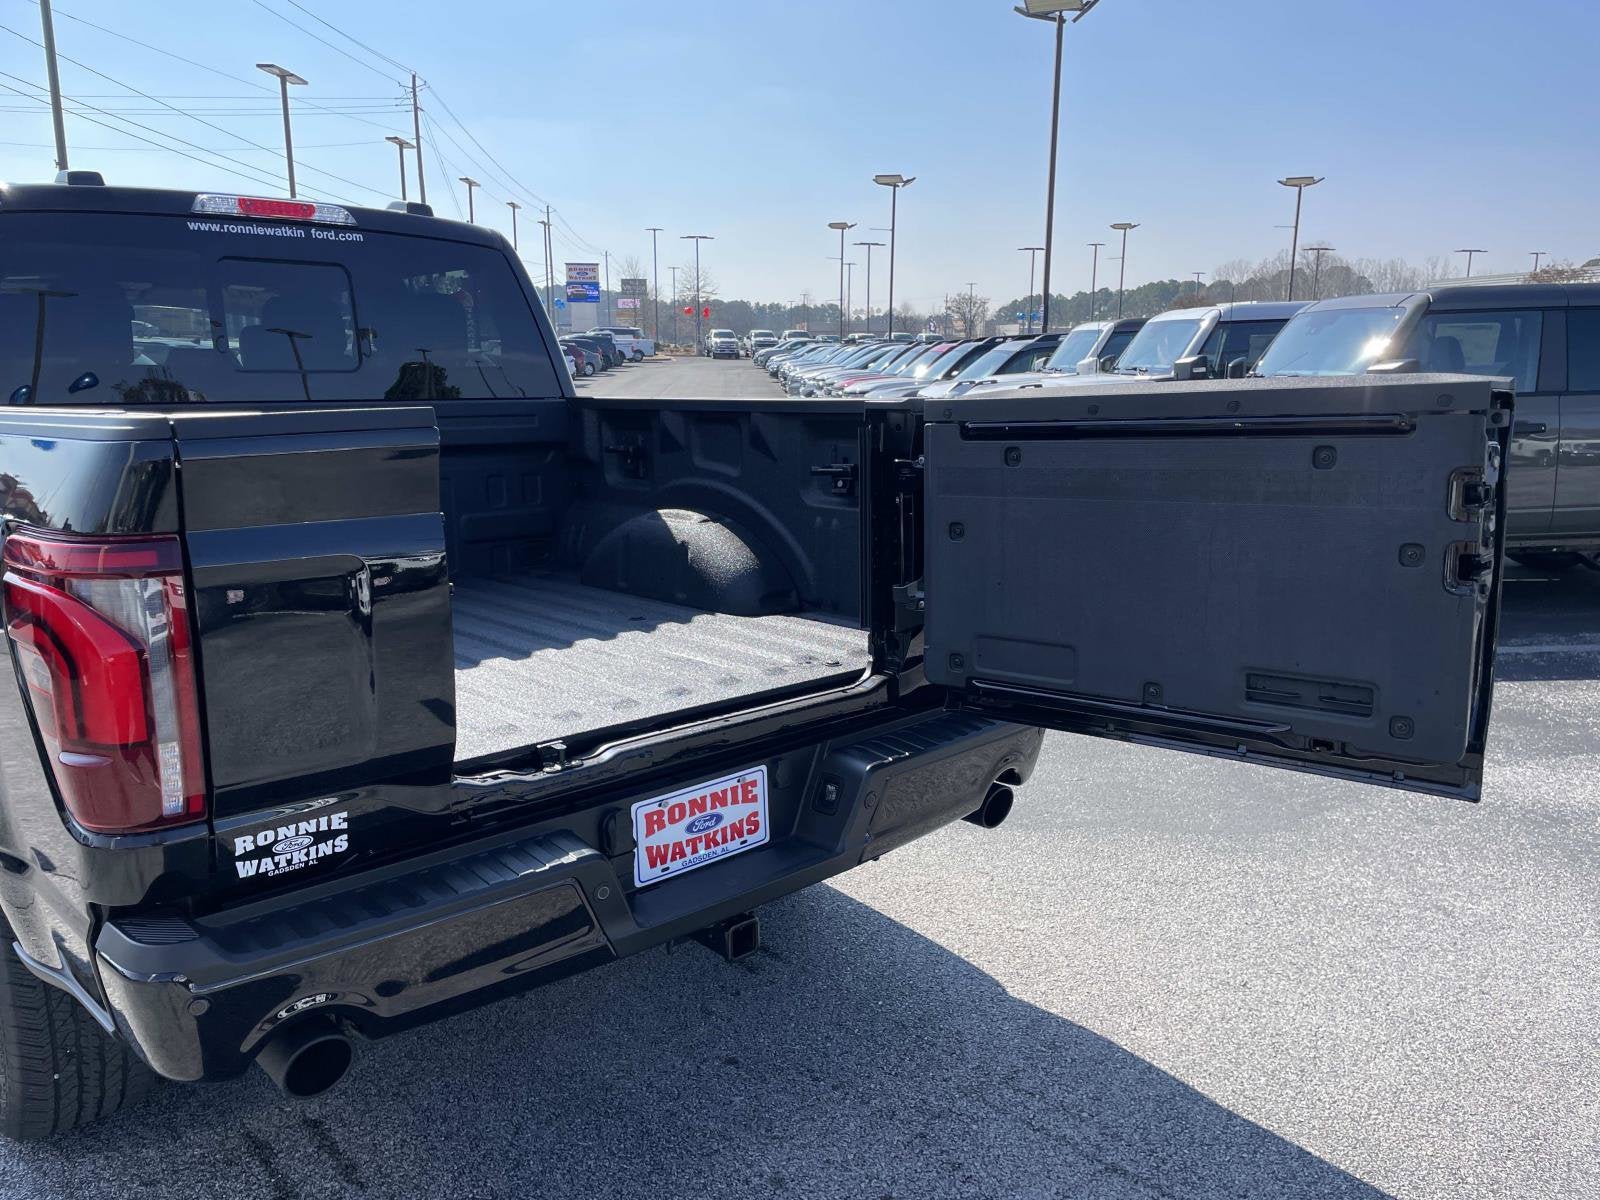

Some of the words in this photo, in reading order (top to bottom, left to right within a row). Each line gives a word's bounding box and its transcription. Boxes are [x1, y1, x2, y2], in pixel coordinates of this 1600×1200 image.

[644, 779, 759, 838] RONNIE
[691, 814, 718, 833] Ford
[234, 811, 348, 856] RONNIE
[279, 837, 307, 852] Ford
[645, 811, 760, 869] WATKINS
[235, 834, 349, 878] WATKINS
[308, 859, 319, 867] AL
[720, 846, 730, 854] AL
